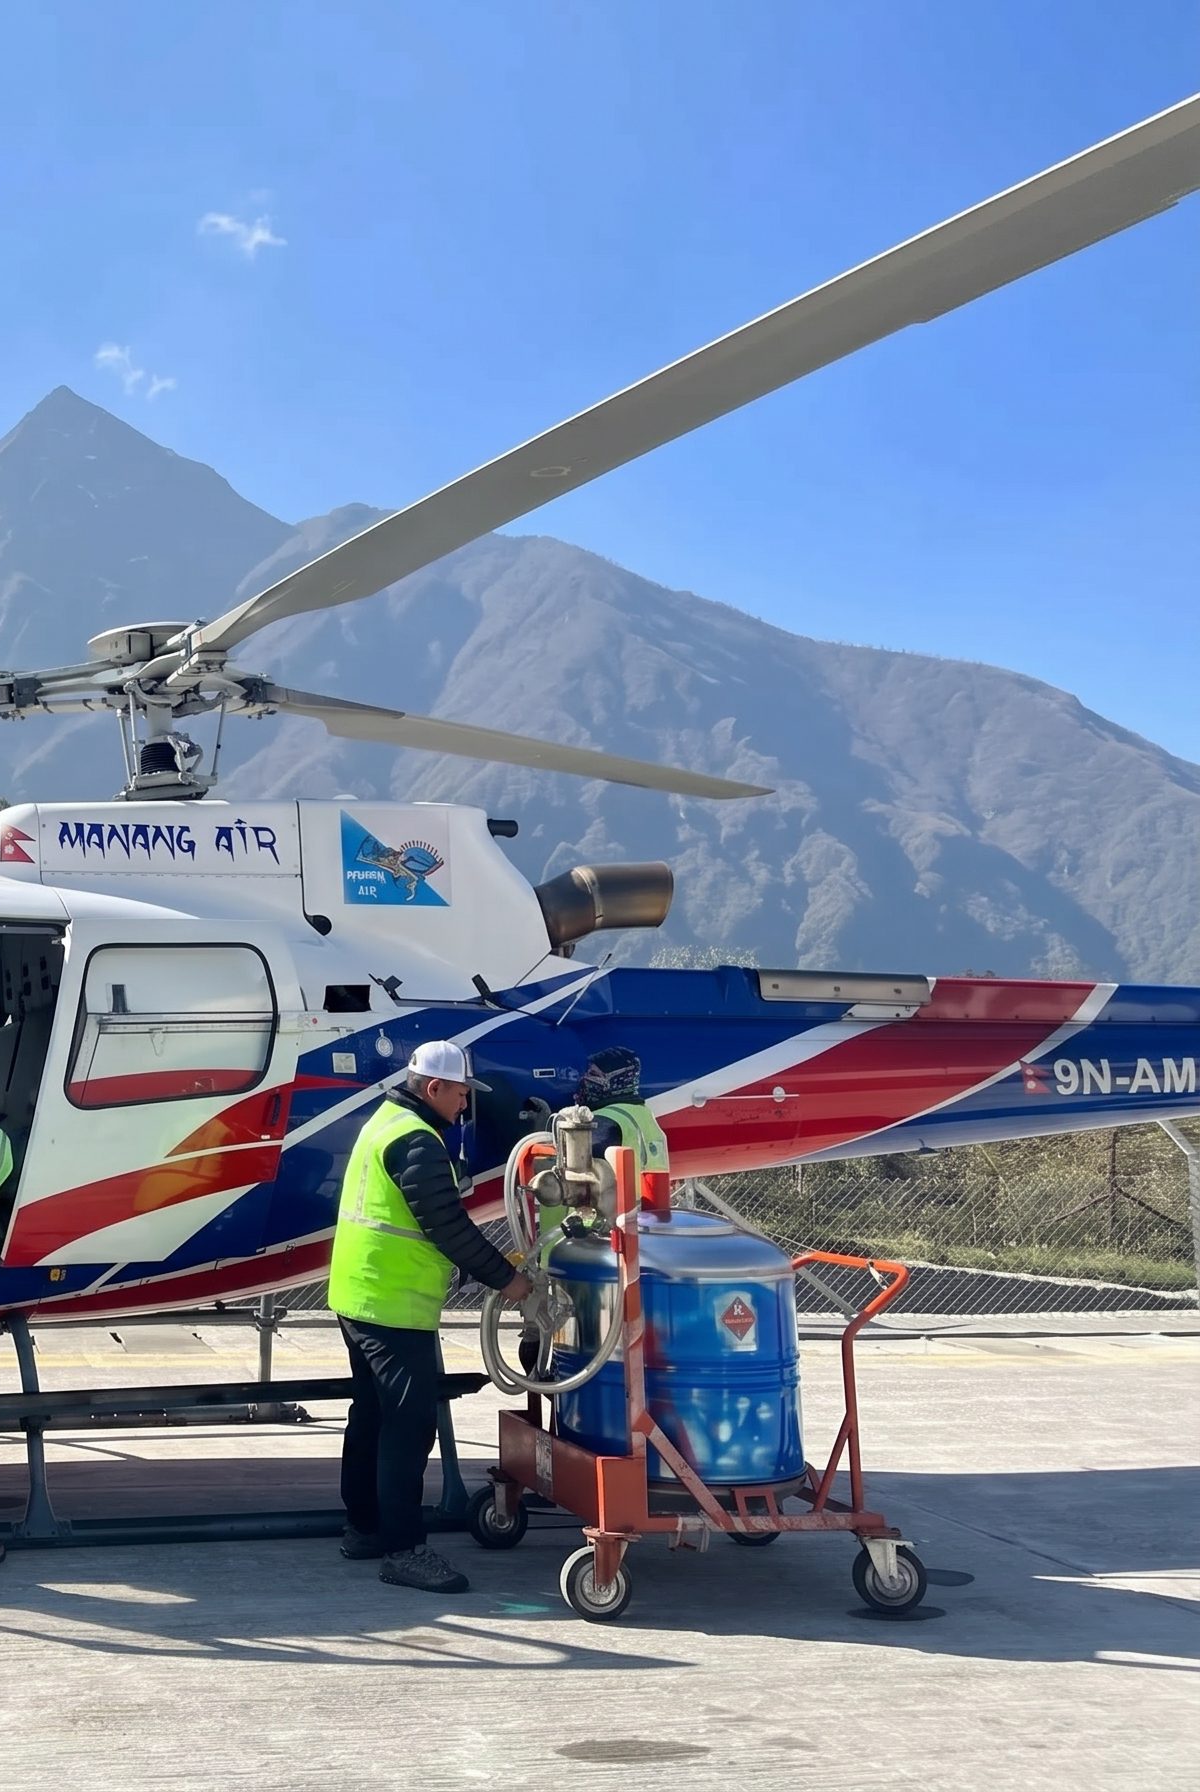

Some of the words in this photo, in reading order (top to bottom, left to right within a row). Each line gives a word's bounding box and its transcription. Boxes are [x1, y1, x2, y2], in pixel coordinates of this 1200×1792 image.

[58, 821, 197, 861] MANANG
[358, 885, 378, 898] AIR
[1053, 1057, 1196, 1096] 9N-AM
